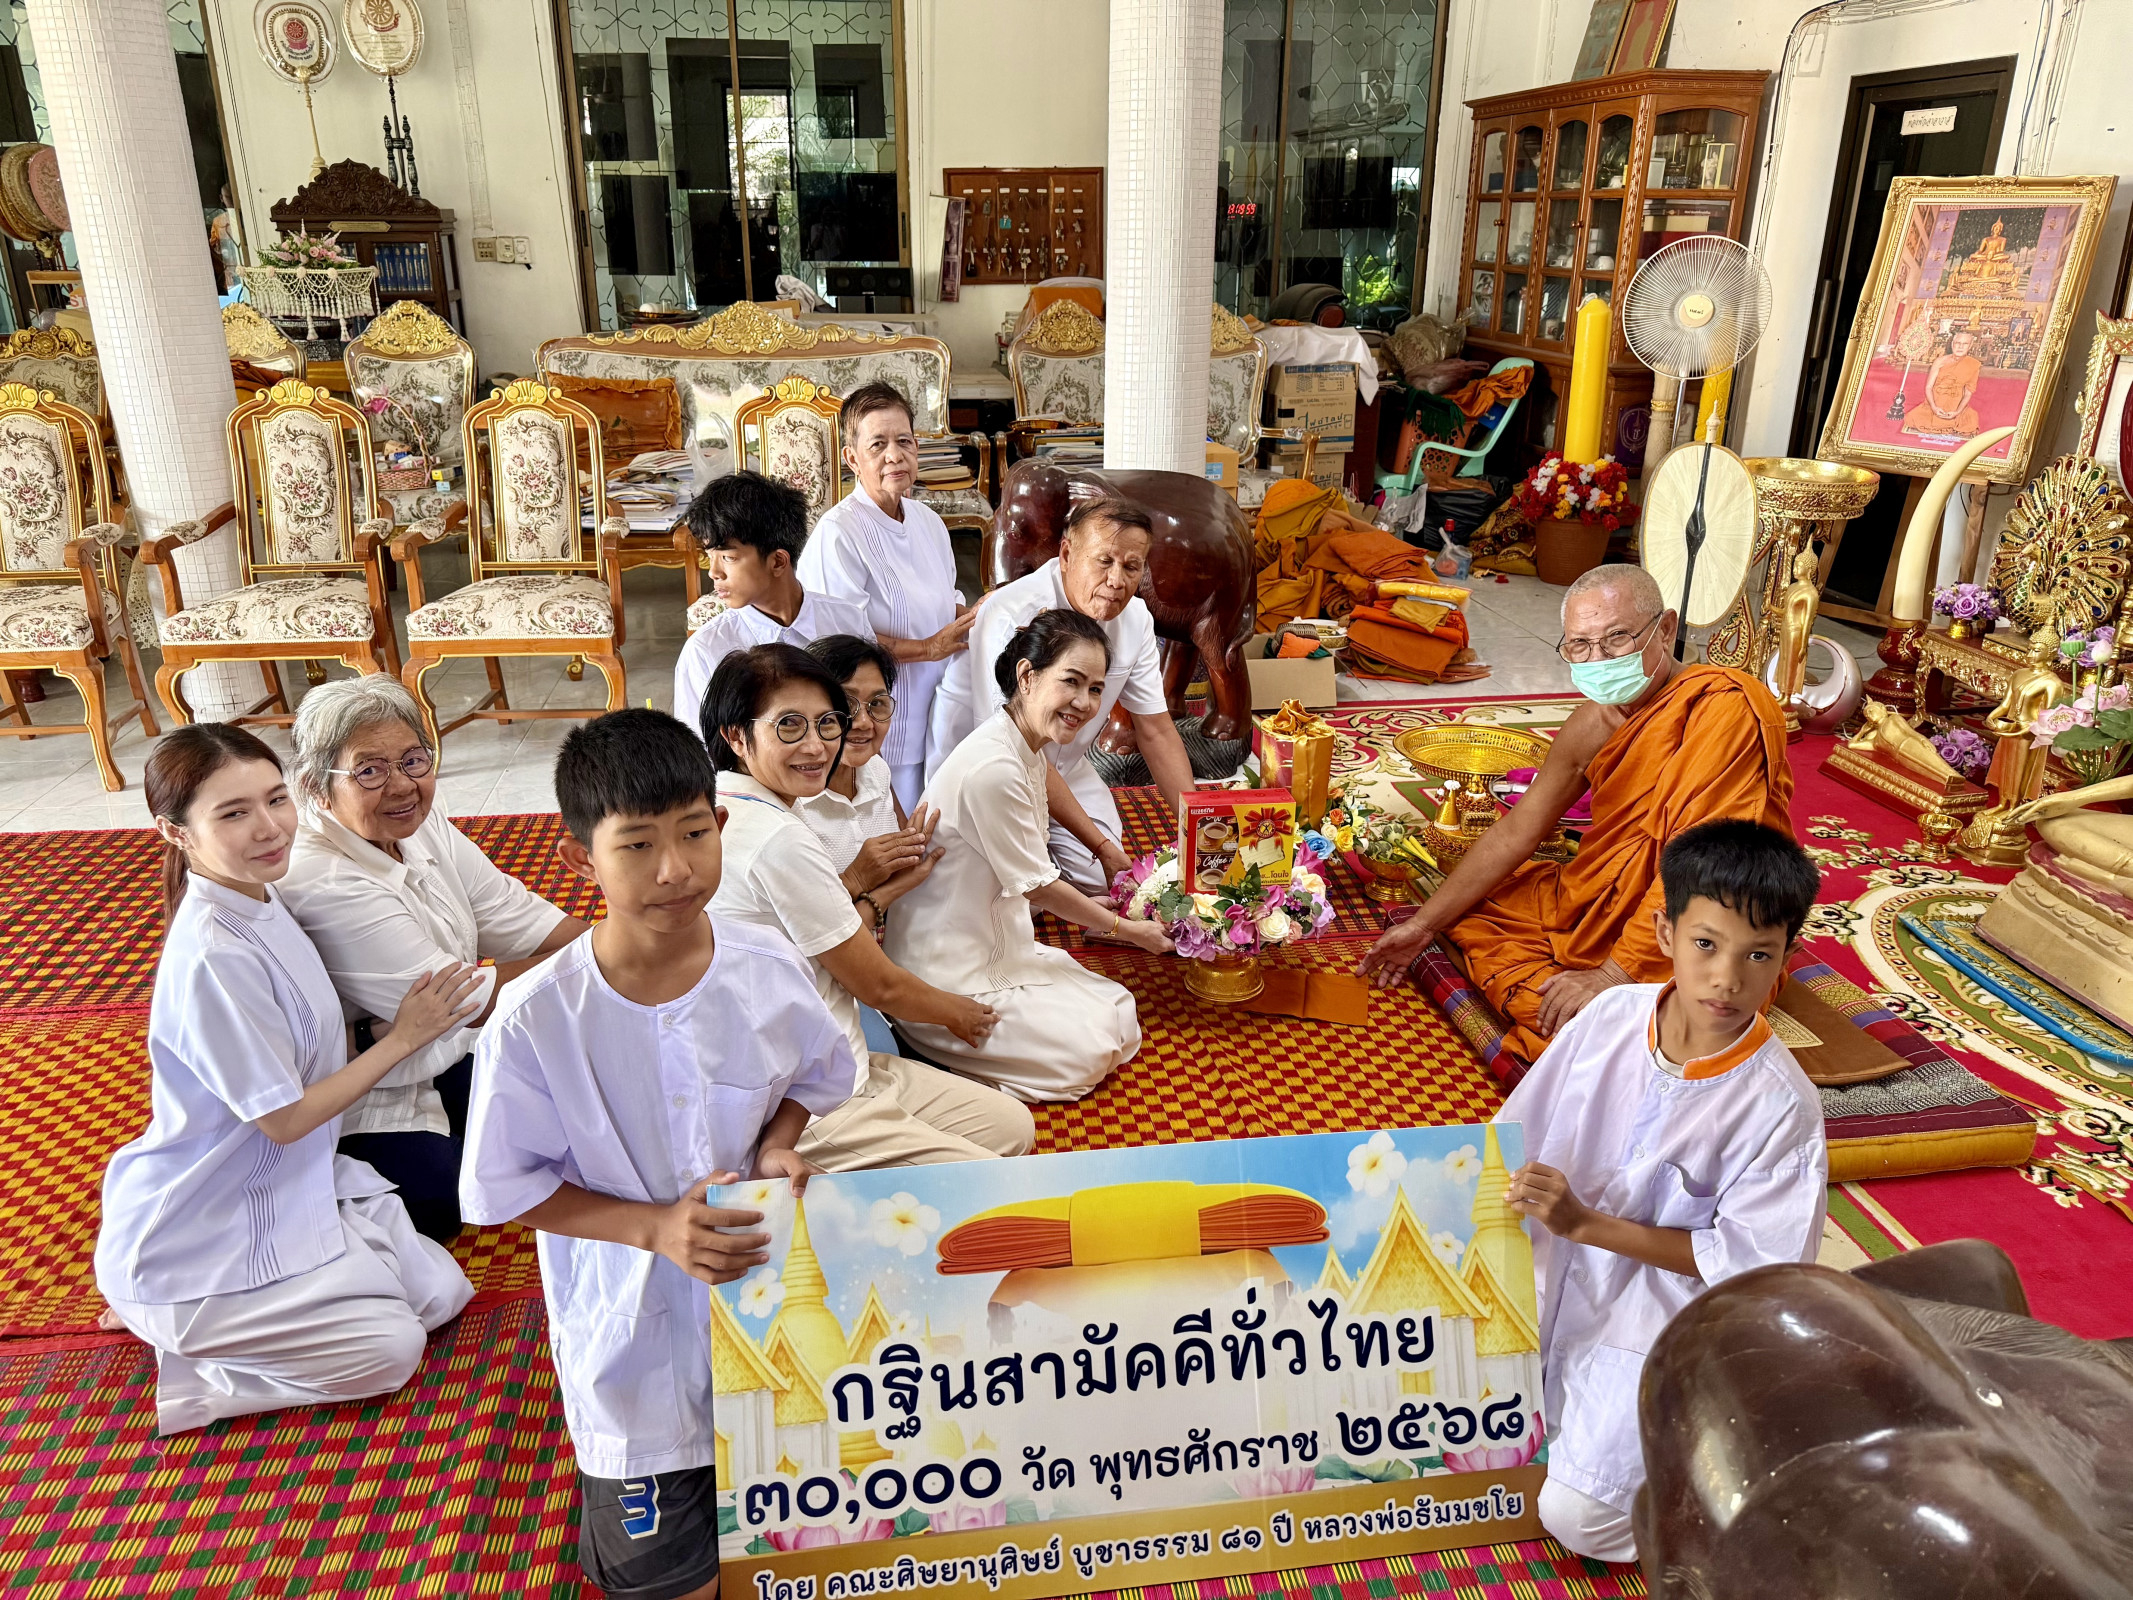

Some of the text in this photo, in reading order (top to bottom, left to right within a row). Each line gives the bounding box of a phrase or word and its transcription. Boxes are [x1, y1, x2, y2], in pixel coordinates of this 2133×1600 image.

[1203, 854, 1227, 868] Coffee
[832, 1287, 1435, 1440] กฐินสามัคคีทั่วไทย
[744, 1392, 1526, 1526] ๓๐,๐๐๐ วัด พุทธศักราช ๒๕๖๘
[757, 1488, 1522, 1600] โดย คณะศิษยานุศิษย์ บูชาธรรม ๘๑ ปี หลวงพ่อธัมมชโย
